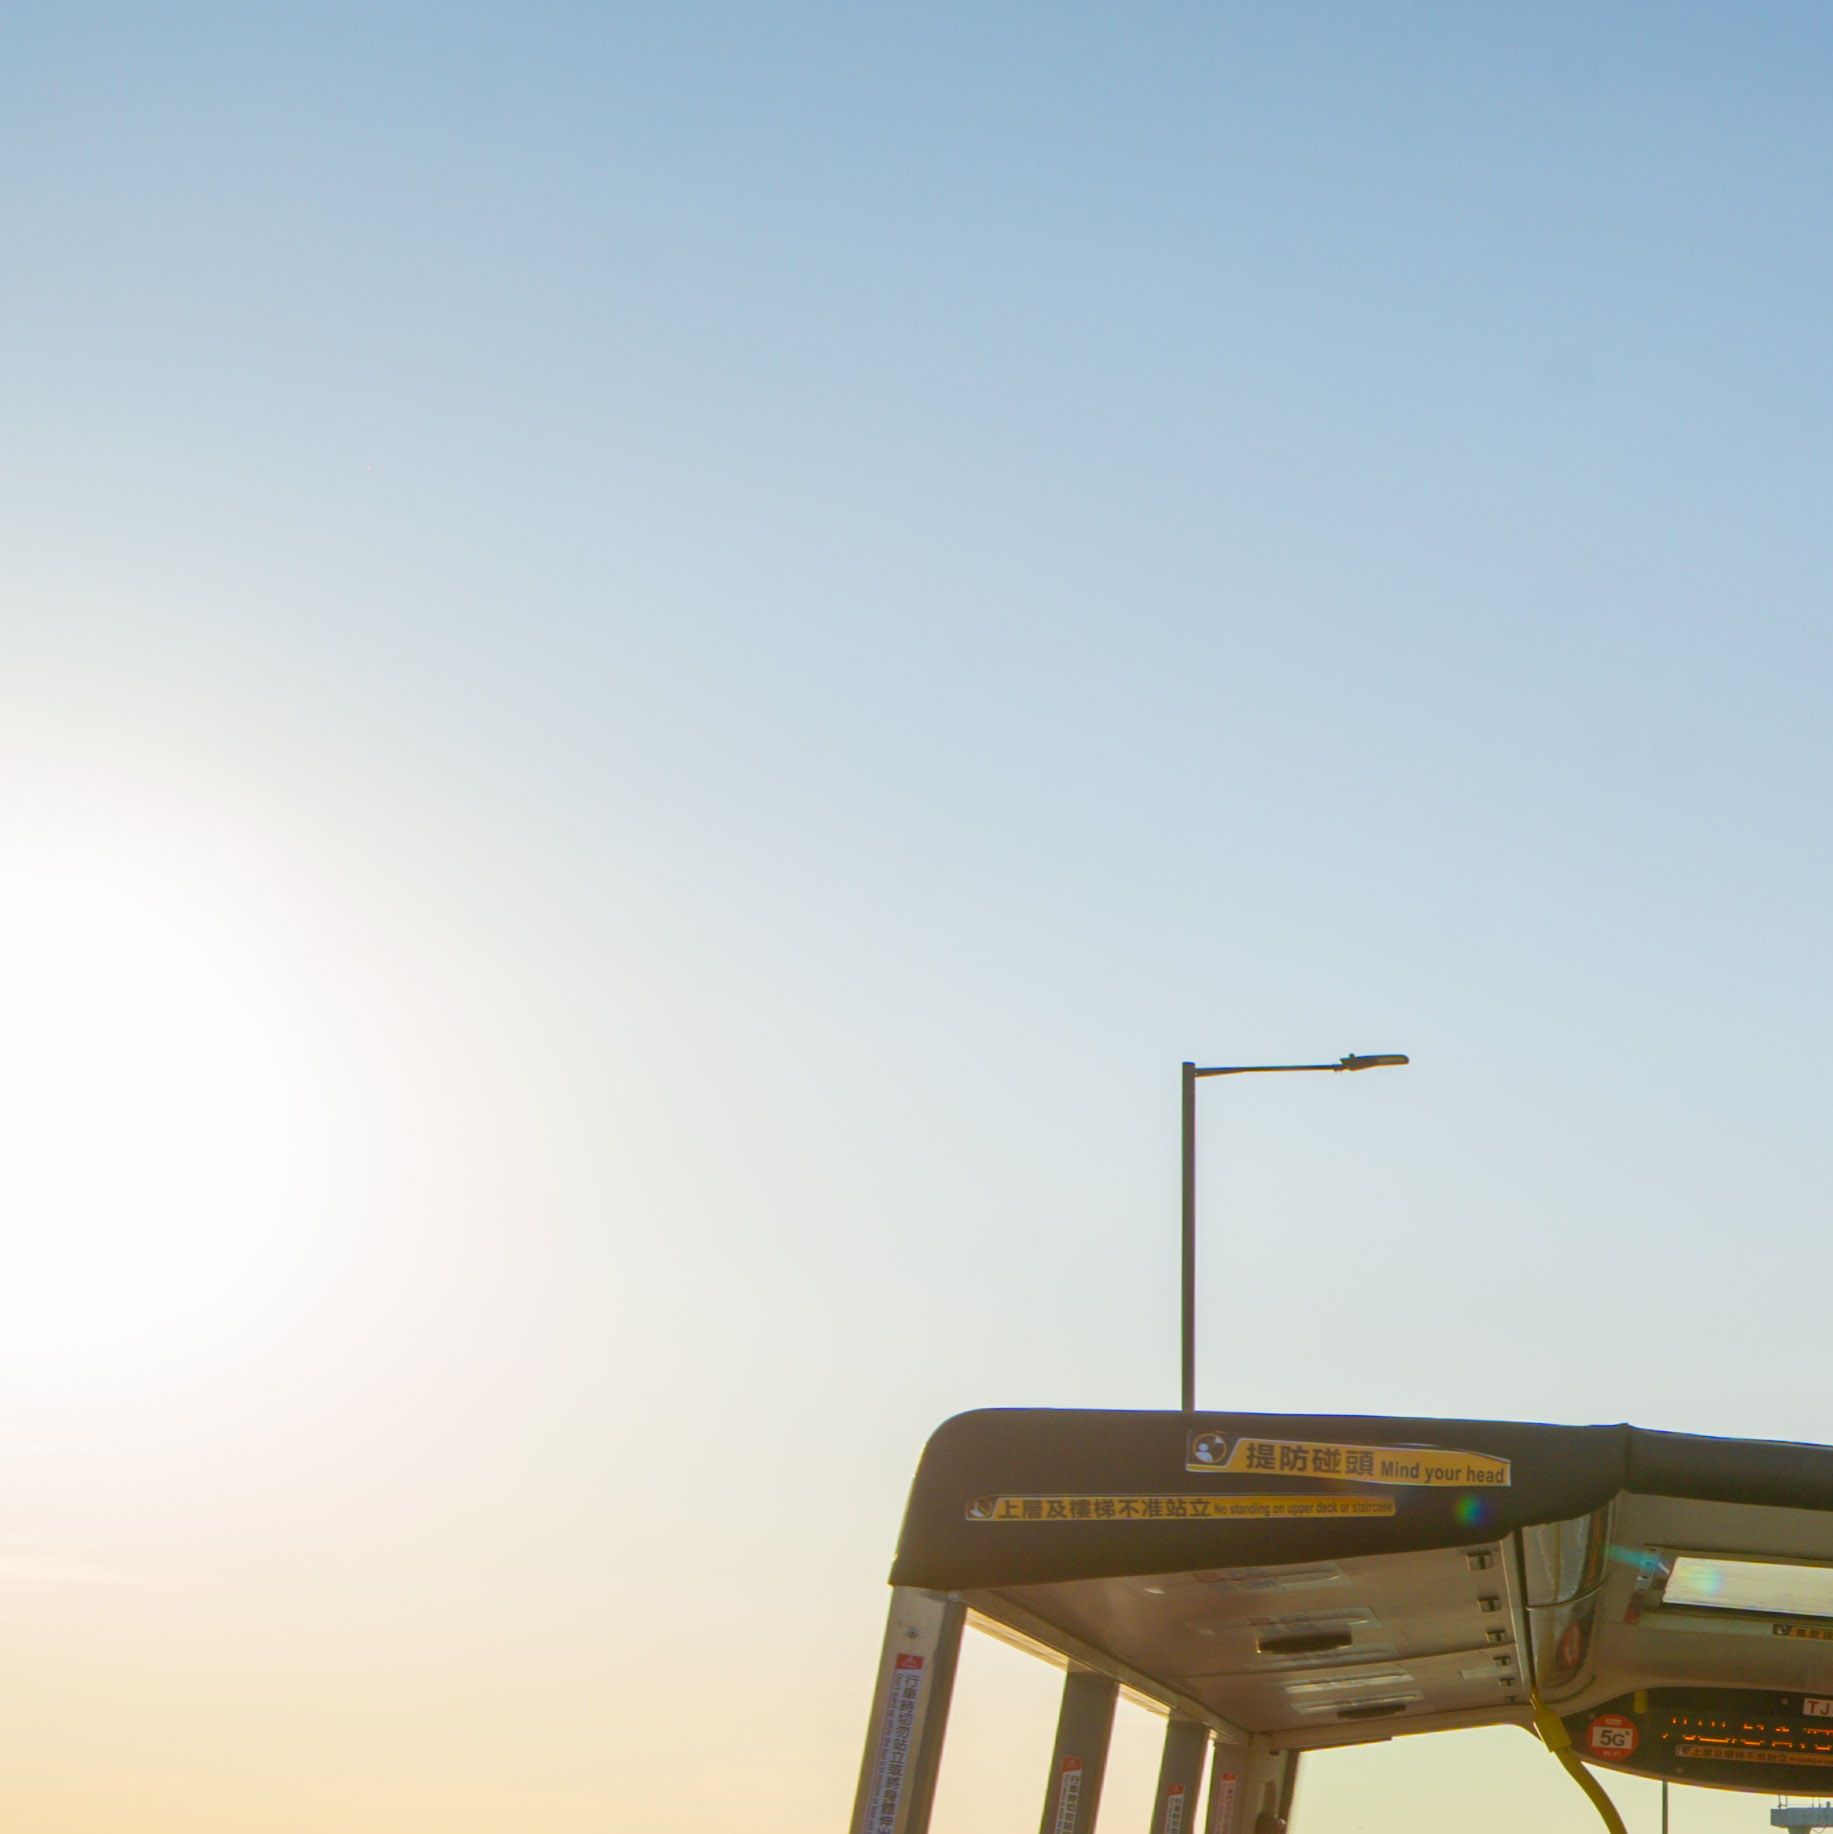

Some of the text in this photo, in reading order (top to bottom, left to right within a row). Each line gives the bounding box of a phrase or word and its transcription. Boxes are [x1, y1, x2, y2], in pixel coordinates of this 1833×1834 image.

[1246, 1442, 1504, 1484] 提防碰頭 Mind your head
[998, 1498, 1212, 1519] 上層及樓梯不准站立
[1214, 1503, 1227, 1514] No
[1230, 1503, 1270, 1516] standing
[1273, 1505, 1285, 1514] on
[1288, 1504, 1313, 1516] upper
[1317, 1502, 1337, 1514] deck
[1352, 1502, 1393, 1514] staircase
[1600, 1729, 1625, 1747] 5G
